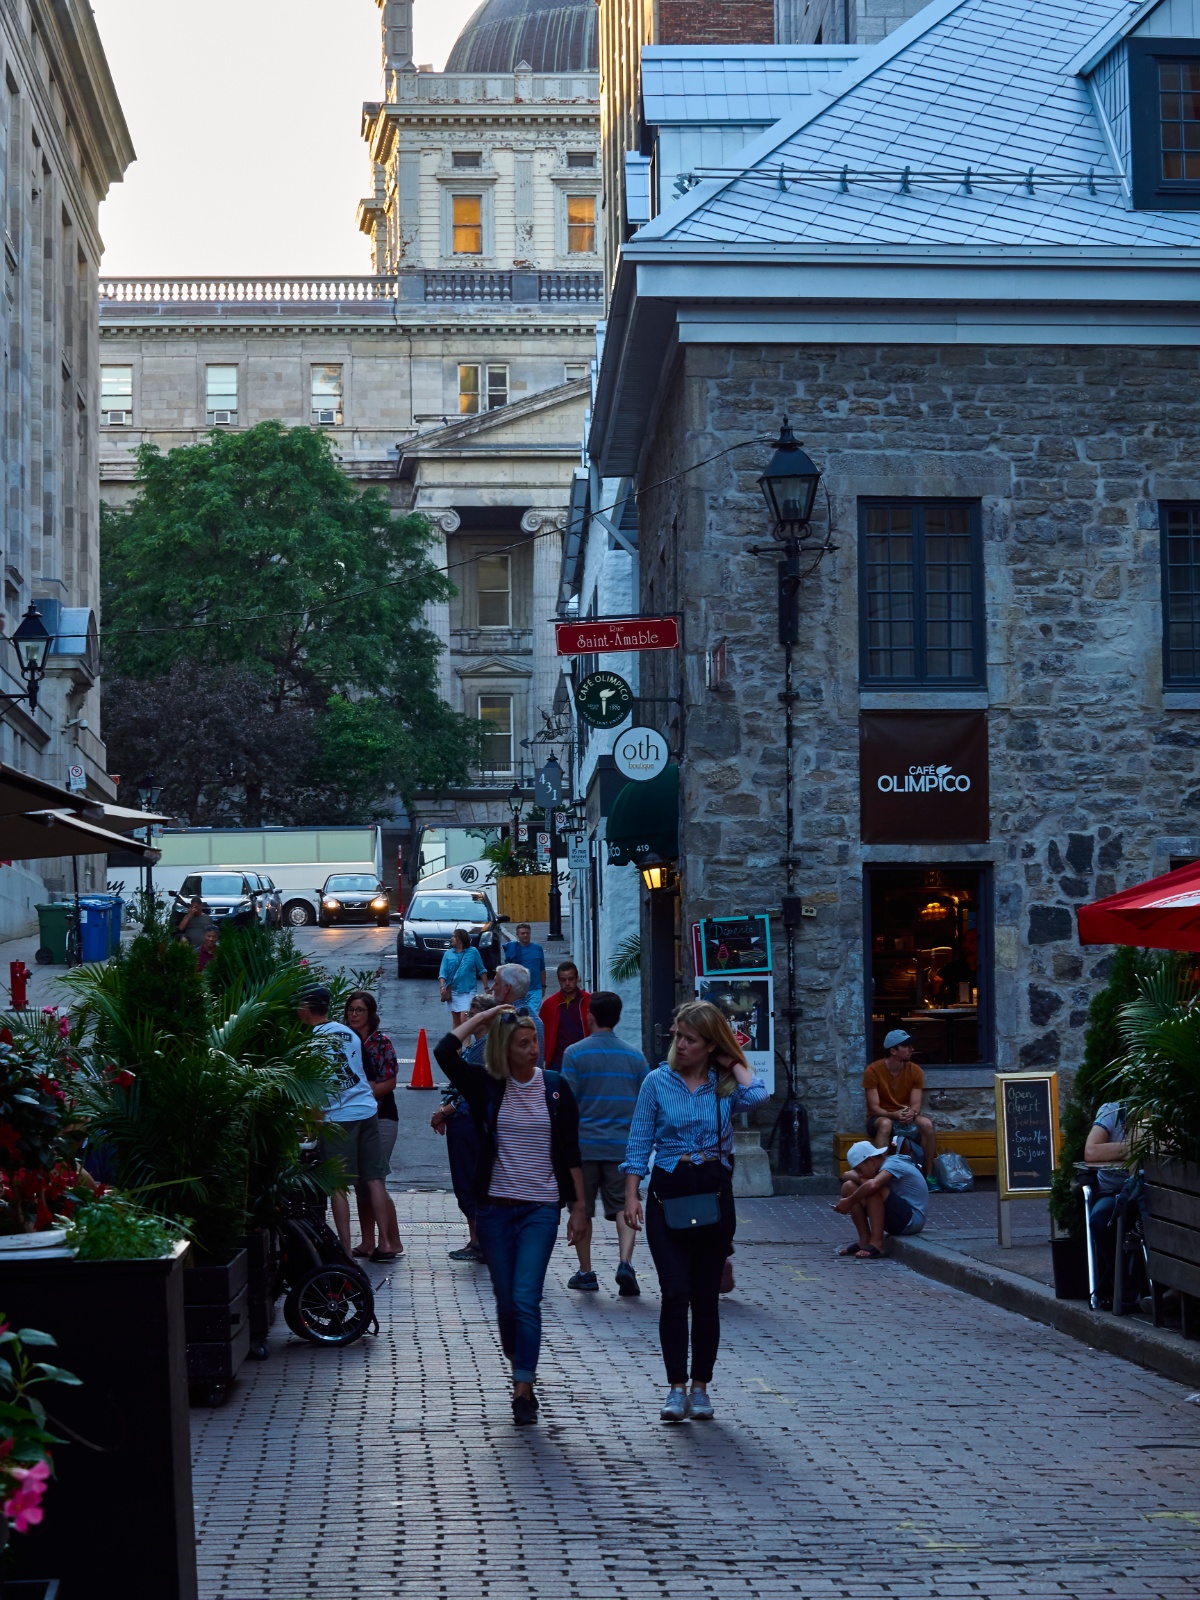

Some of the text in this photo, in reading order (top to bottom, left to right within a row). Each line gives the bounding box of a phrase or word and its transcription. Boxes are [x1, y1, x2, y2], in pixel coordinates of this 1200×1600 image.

[577, 630, 659, 648] Saint-Amable
[594, 675, 629, 701] OLIMPICO
[622, 734, 660, 761] oth
[628, 761, 654, 771] boutique
[908, 764, 935, 775] CAFÉ
[877, 774, 971, 793] OLIMPICO
[575, 836, 584, 848] P
[636, 844, 650, 852] 419
[1008, 1087, 1037, 1100] Open
[1017, 1145, 1045, 1163] Bijoux
